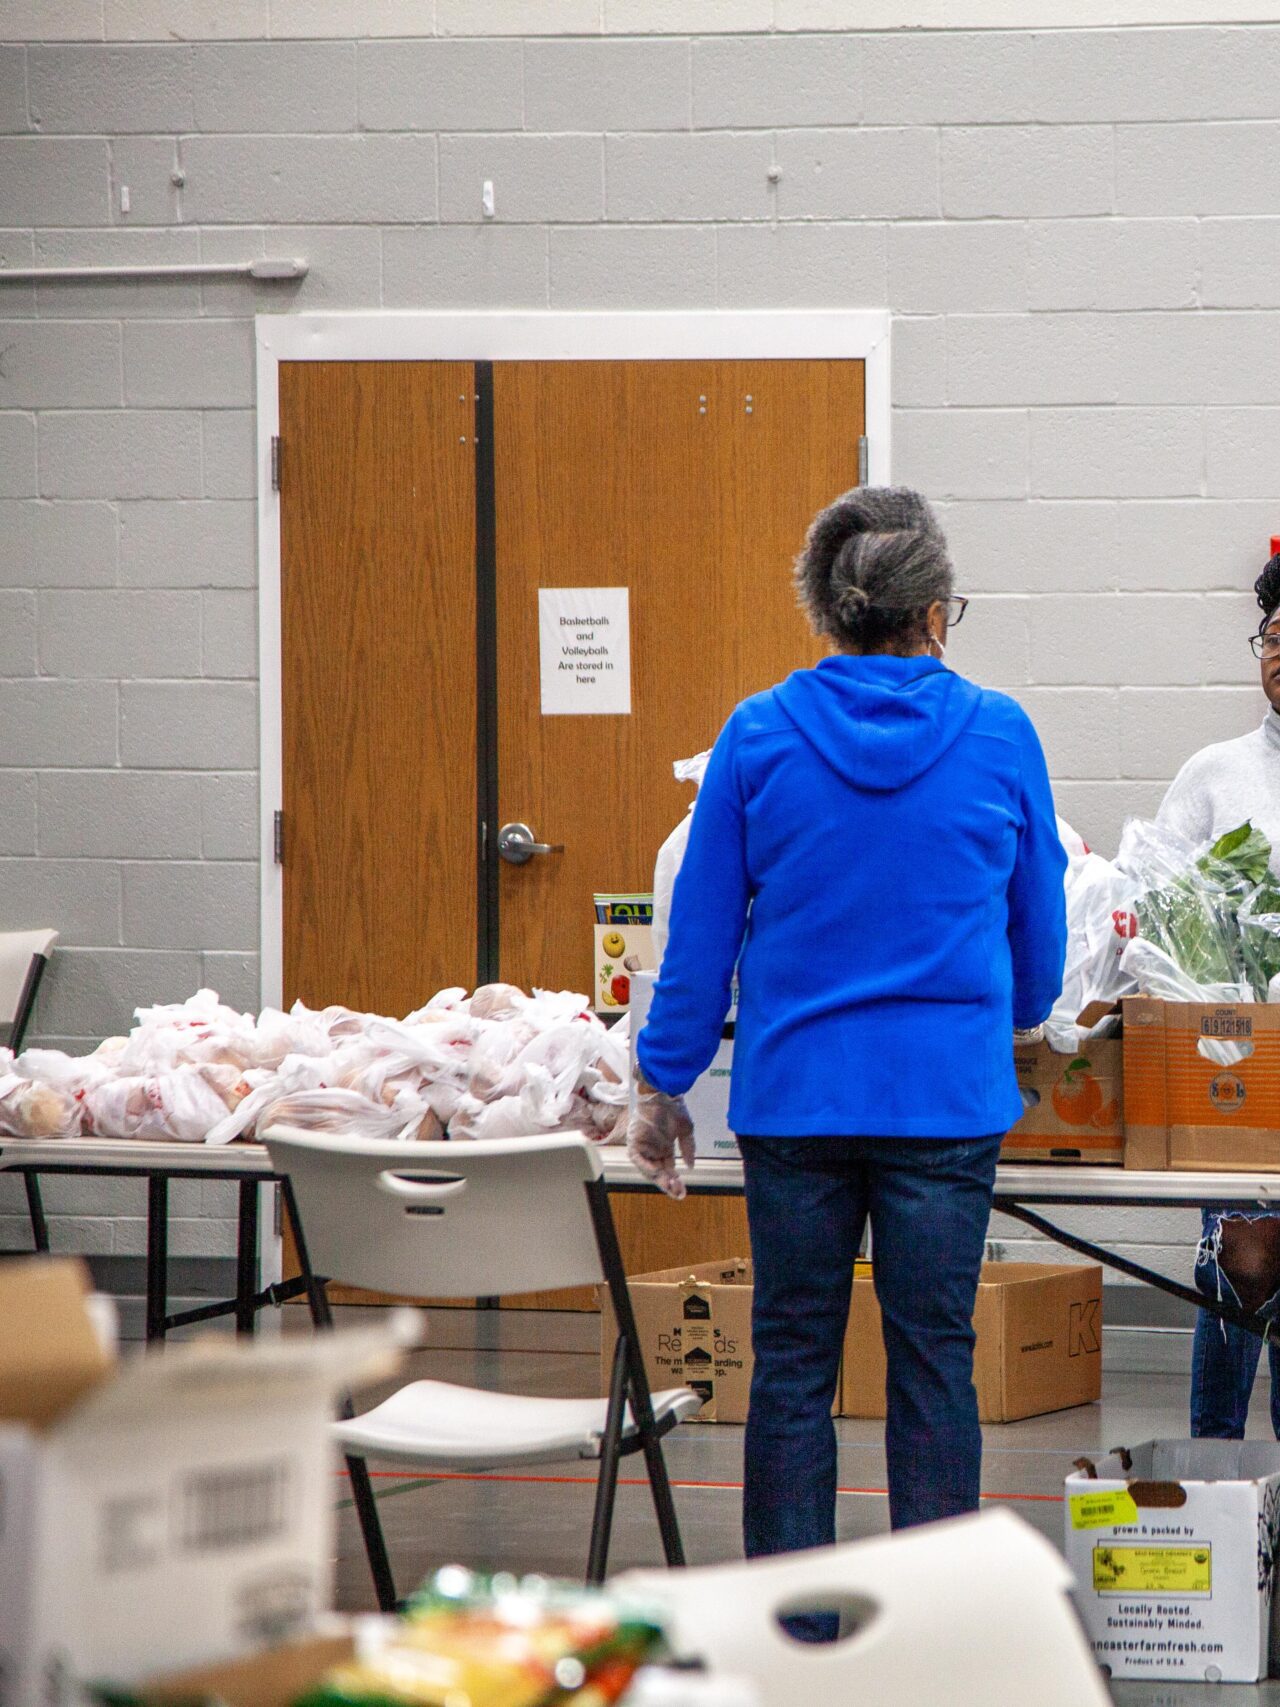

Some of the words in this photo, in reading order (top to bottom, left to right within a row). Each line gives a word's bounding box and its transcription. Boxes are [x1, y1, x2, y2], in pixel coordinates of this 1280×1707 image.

[559, 616, 609, 626] Basketballs
[576, 631, 594, 640] and
[561, 646, 609, 656] Volleyballs
[558, 661, 574, 670] Are
[576, 661, 603, 670] stored
[605, 661, 614, 670] in
[576, 674, 596, 683] here
[1069, 1298, 1101, 1358] K
[657, 1333, 737, 1354] Reds
[655, 1356, 672, 1365] The
[714, 1358, 743, 1369] arding
[671, 1367, 683, 1375] wa
[1112, 1526, 1138, 1536] grown
[1142, 1525, 1148, 1534] &
[1151, 1526, 1181, 1536] packed
[1184, 1526, 1194, 1537] by
[1118, 1604, 1152, 1617] Locally
[1107, 1617, 1163, 1631] Sustainably
[1090, 1639, 1224, 1653] ancasterfarmfresh.com
[1124, 1657, 1153, 1665] Product
[1156, 1658, 1164, 1666] of
